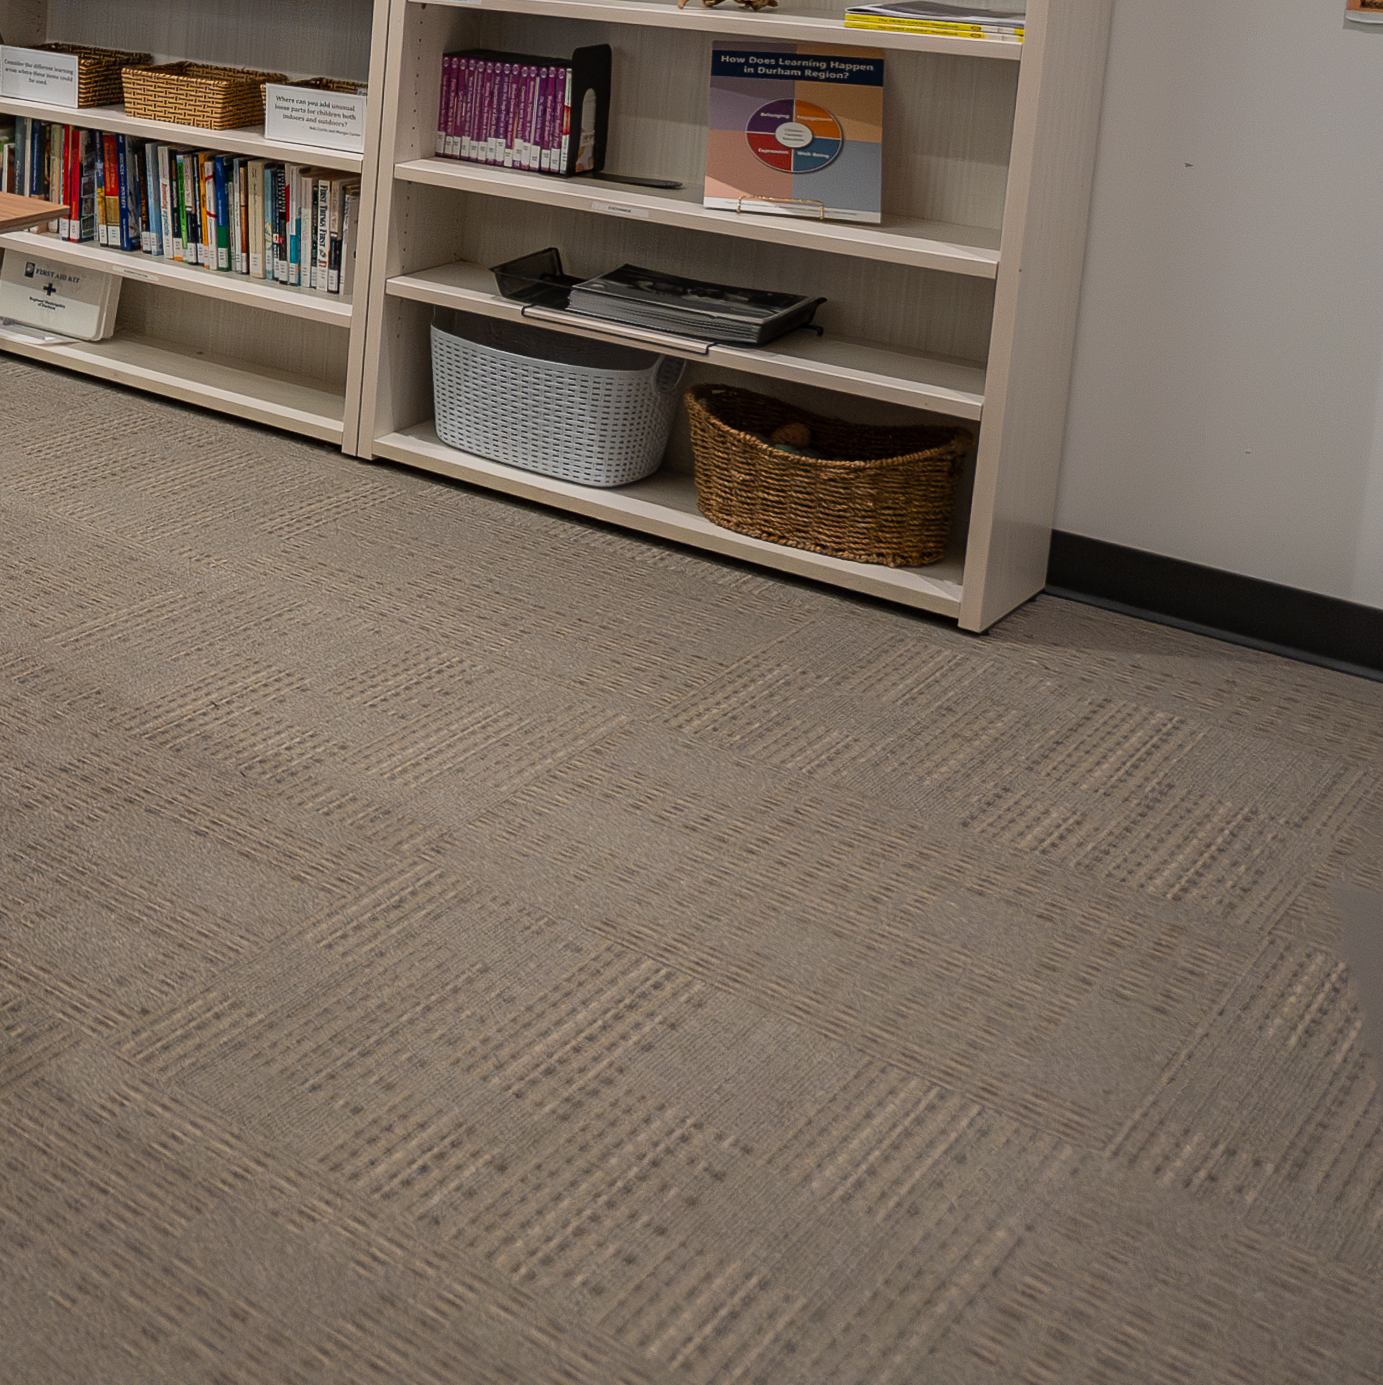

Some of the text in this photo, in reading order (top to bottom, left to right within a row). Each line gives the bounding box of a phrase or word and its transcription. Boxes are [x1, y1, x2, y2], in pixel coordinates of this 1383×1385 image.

[33, 63, 54, 71] different
[54, 66, 74, 76] learning
[720, 55, 875, 72] How Does Learning Happen
[743, 65, 850, 80] in Durham Region?
[275, 95, 295, 104] Where
[319, 100, 331, 108] add
[331, 103, 356, 112] unusual
[274, 104, 357, 121] loose parts for children both
[282, 113, 348, 128] indoors and outdoors?
[760, 112, 790, 120] Belonging
[318, 185, 329, 247] FIRST THINGS FIRST
[35, 268, 81, 284] FIRST AID KIT
